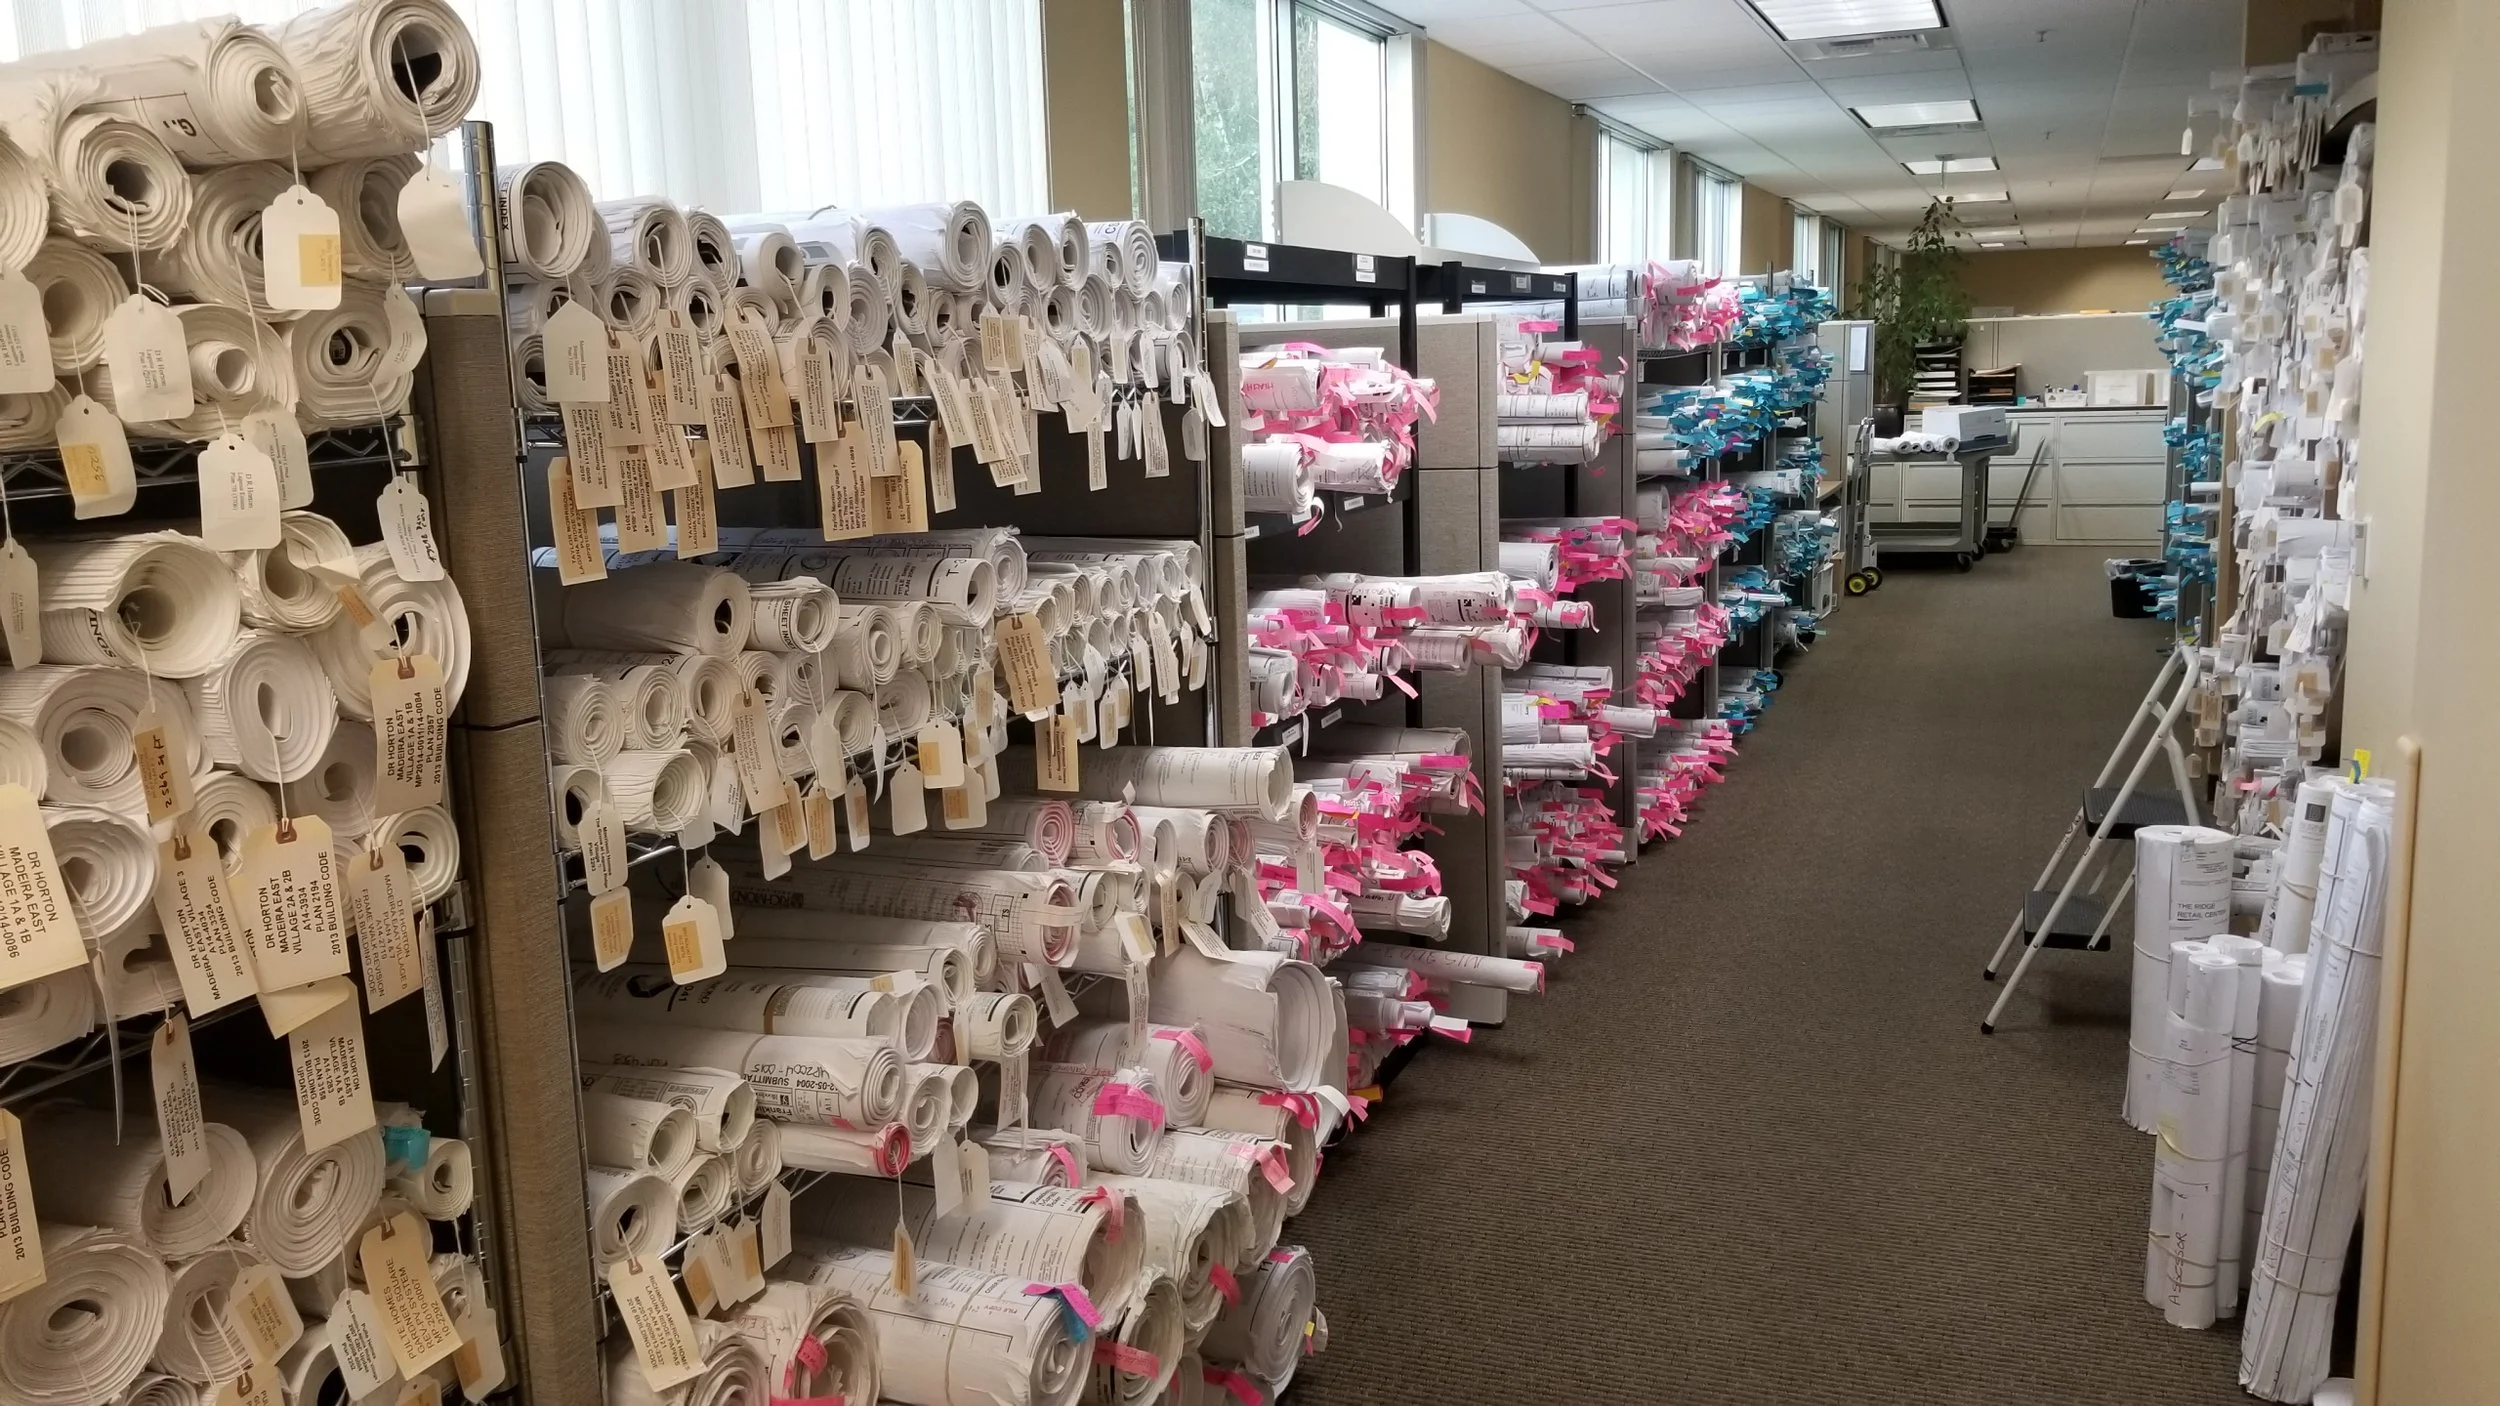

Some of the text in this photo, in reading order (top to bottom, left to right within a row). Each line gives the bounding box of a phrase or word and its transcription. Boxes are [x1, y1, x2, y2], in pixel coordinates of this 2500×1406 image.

[499, 196, 509, 230] INDEX
[781, 600, 790, 628] SHEET
[405, 702, 412, 714] 1B
[386, 717, 394, 775] DR HORTON
[405, 727, 412, 739] 1A
[405, 742, 413, 782] VILLAGE
[8, 846, 45, 935] MADEIRA EAST
[26, 850, 57, 921] DR HORTON
[281, 869, 292, 883] 2B
[8, 898, 31, 943] 1A & 1B
[178, 878, 197, 922] VILLAGE
[258, 887, 275, 948] DR HORTON
[269, 876, 289, 952] MADEIRA EAST
[285, 894, 295, 907] 2A
[297, 886, 311, 931] A14-3934
[310, 880, 324, 932] PLAN 2194
[318, 851, 341, 955] 2013 BUILDING CODE
[176, 909, 201, 969] DR HORTON
[206, 874, 243, 976] 2013 BUILDING CODE
[212, 927, 226, 954] PLAN
[287, 910, 302, 954] VILLAGE
[361, 888, 385, 996] FRAME WALK REVISION
[382, 910, 391, 935] PLAN
[354, 897, 376, 994] 2013 BUILDING CODE
[394, 943, 406, 980] VILLAGE
[201, 954, 221, 1000] MADEIRA
[301, 1039, 321, 1125] 2013 BUILDING CODE
[313, 1057, 323, 1080] PLAN
[328, 1036, 340, 1073] VILLAGE
[334, 1075, 342, 1086] 1A
[337, 1036, 352, 1098] MADEIRA EAST
[349, 1054, 360, 1090] HORTON
[296, 1066, 308, 1105] UPDATES
[796, 1079, 838, 1090] 2-05-2004
[755, 1106, 793, 1115] Frankli
[0, 1149, 24, 1259] 2013 BUILDING CODE
[384, 1257, 426, 1354] GARDNER SQUARE
[398, 1266, 417, 1309] SYSTEM
[644, 1285, 660, 1315] LAGUNA
[648, 1275, 666, 1312] RICHMOND
[381, 1286, 416, 1359] PULTE HOMES
[633, 1314, 650, 1348] BUILDING
[646, 1306, 658, 1326] PLAN
